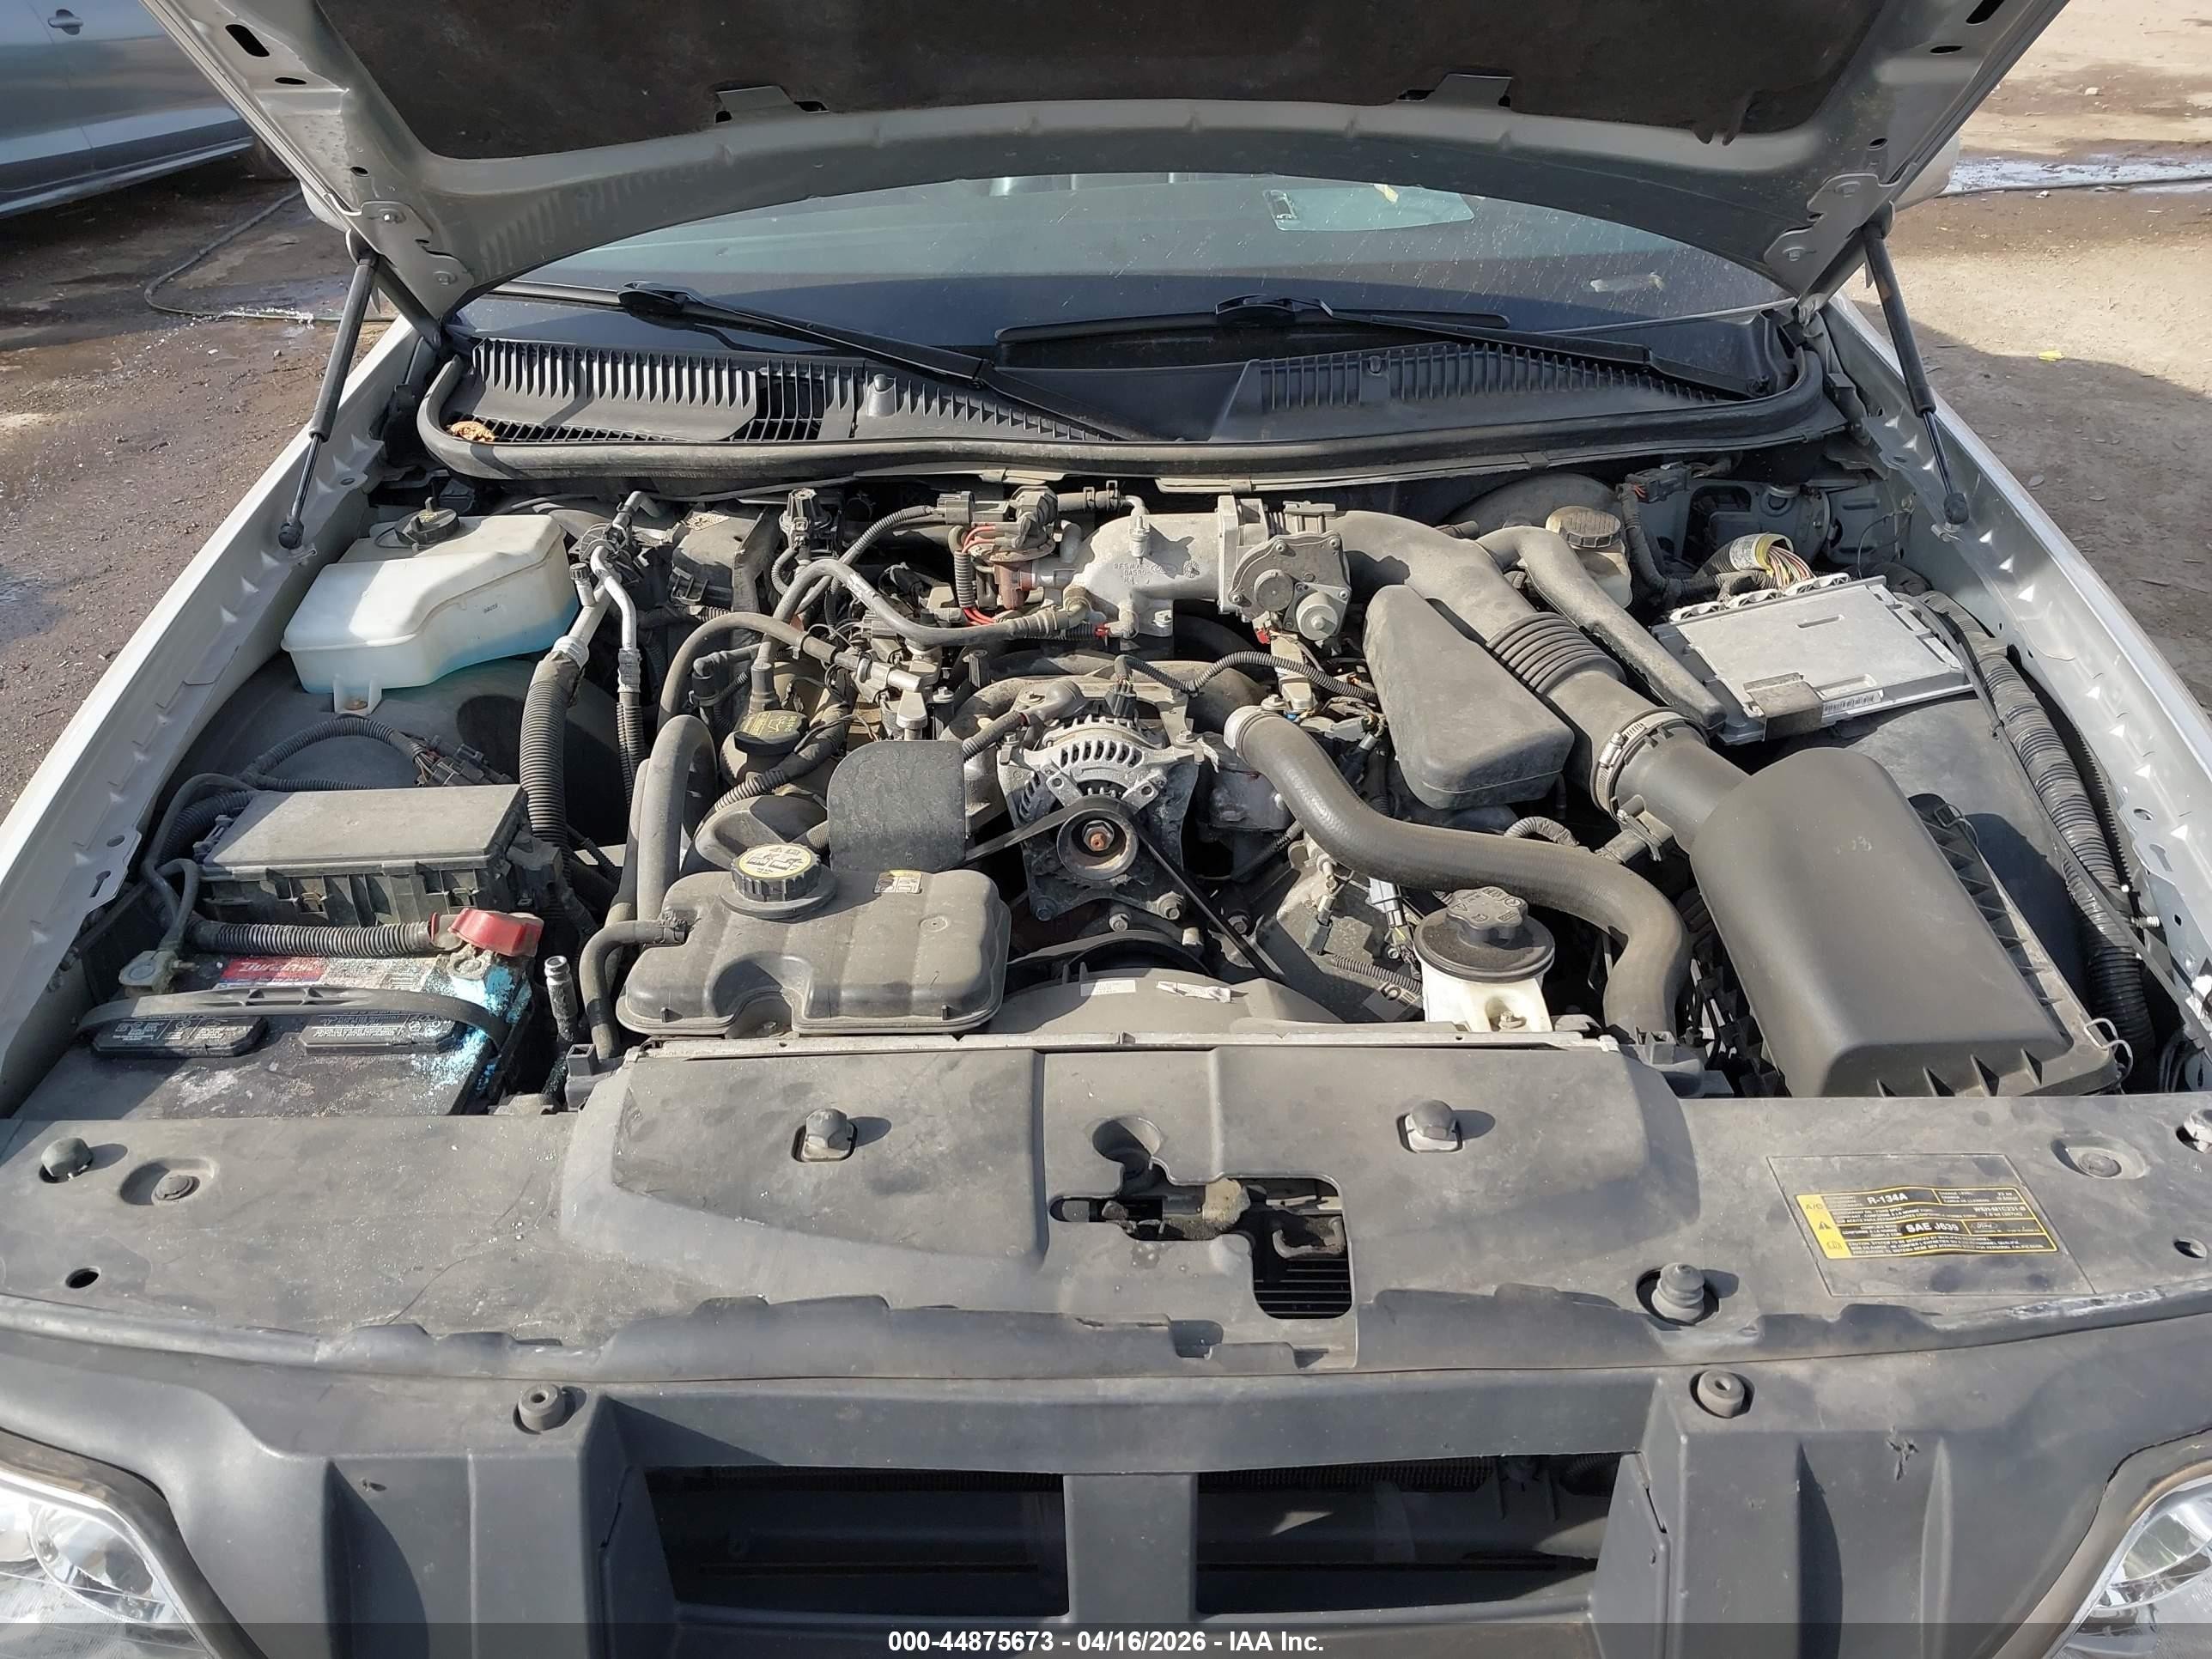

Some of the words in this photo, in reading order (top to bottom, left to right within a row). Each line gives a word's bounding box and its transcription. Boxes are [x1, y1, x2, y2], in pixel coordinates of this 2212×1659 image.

[1867, 1192, 1908, 1205] R-134A
[1905, 1222, 1932, 1233] SAE
[1934, 1222, 1960, 1231] J639
